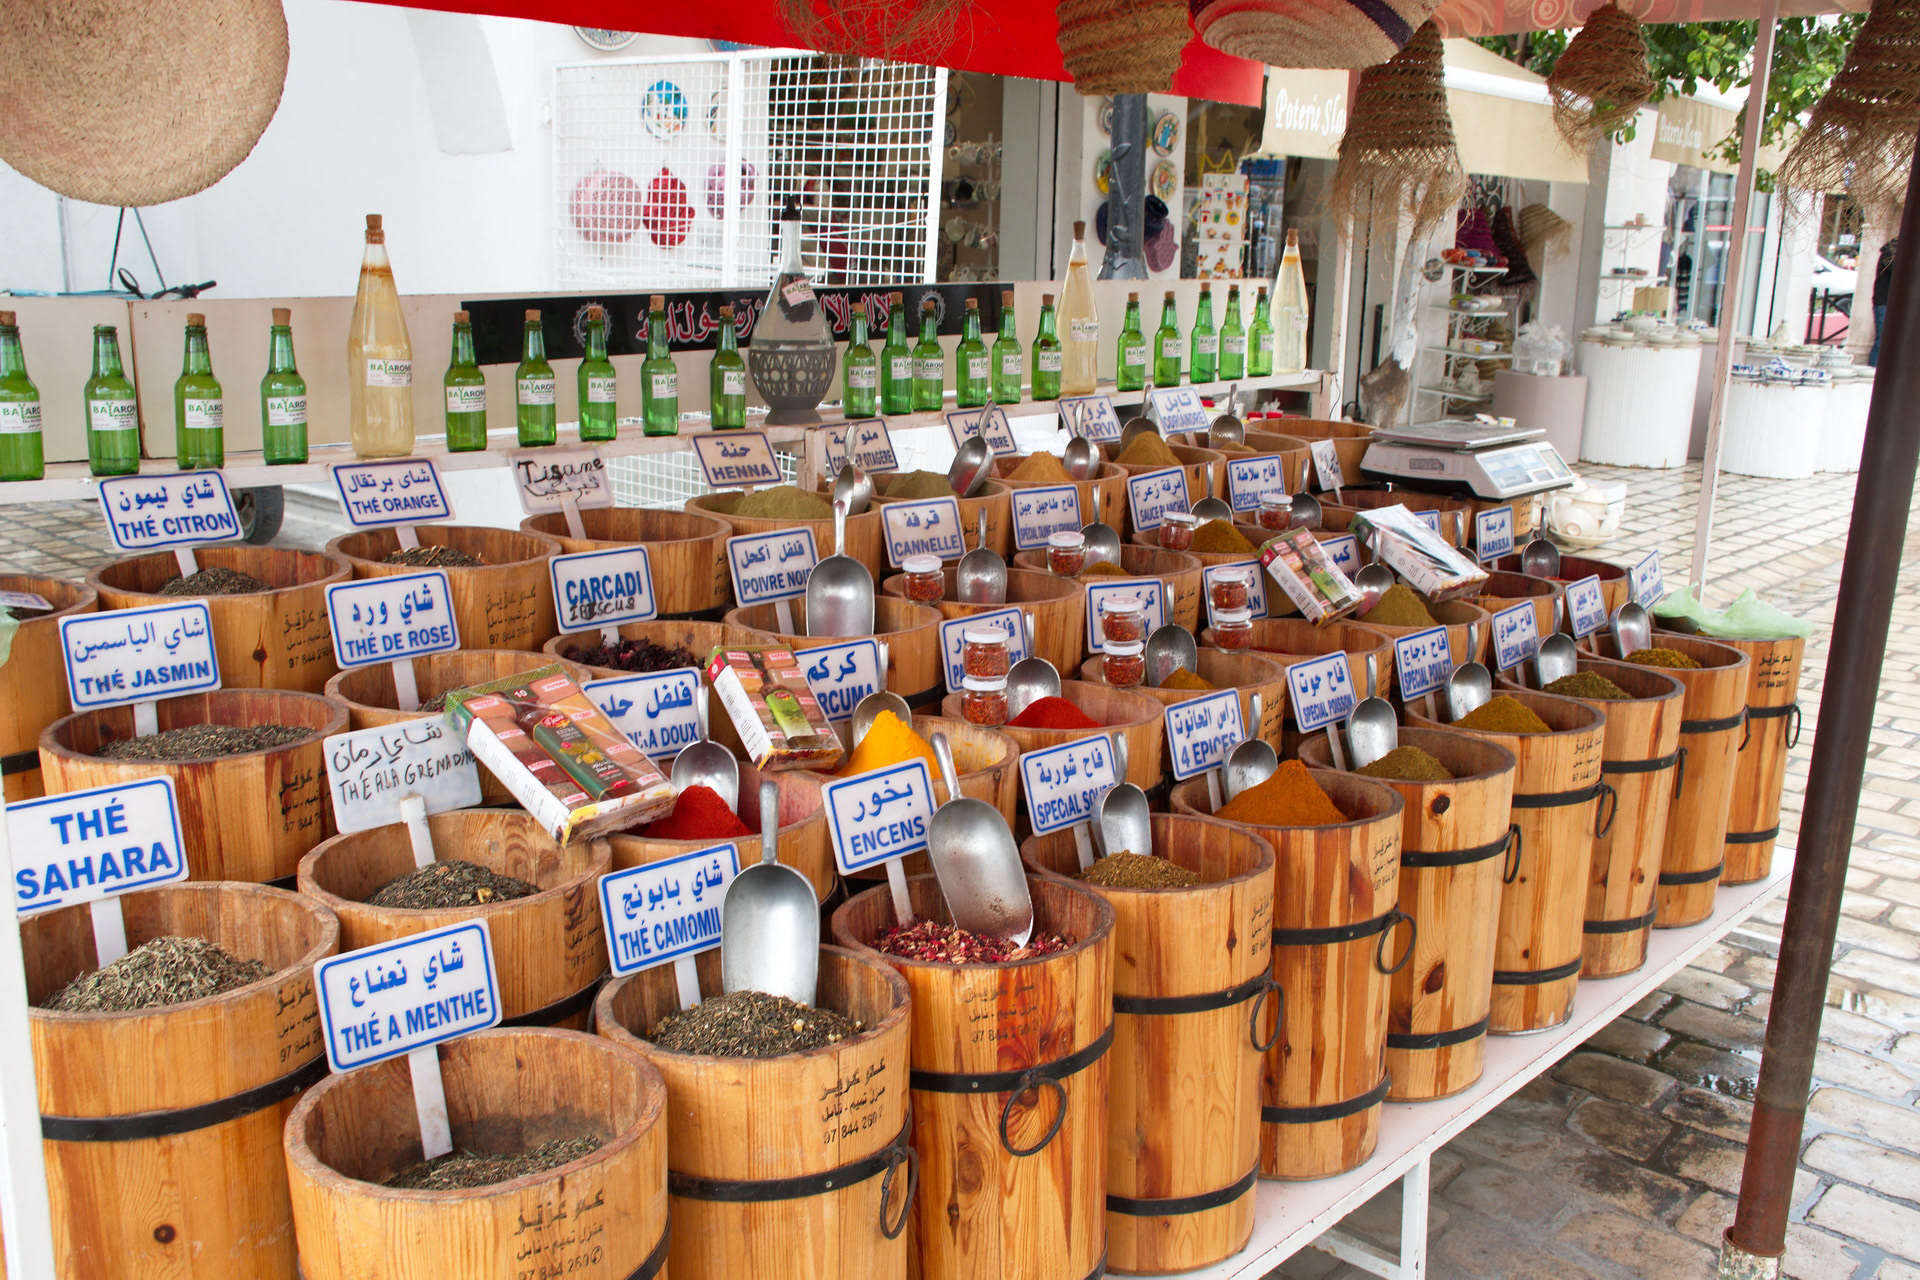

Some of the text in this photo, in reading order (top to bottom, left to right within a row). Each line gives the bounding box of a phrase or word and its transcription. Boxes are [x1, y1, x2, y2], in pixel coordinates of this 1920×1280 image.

[1275, 88, 1347, 136] Poterie Sla
[1165, 392, 1192, 413] تابل
[1084, 421, 1117, 437] ARVI
[1163, 411, 1205, 430] CORIANDRE
[715, 440, 751, 459] حنة
[711, 463, 772, 481] HENNA
[119, 478, 215, 512] شاي ليمون
[352, 494, 439, 515] THÉ ORANGE
[119, 512, 233, 541] THÉ CITRON
[1139, 505, 1160, 522] SAUCE
[741, 539, 805, 569] فلفل أكحل
[893, 534, 960, 557] CANNELLE
[1482, 536, 1511, 555] HARISSA
[565, 571, 643, 605] CARCADI
[743, 572, 784, 595] POIVRE
[352, 583, 435, 627] شاي ورد
[74, 616, 205, 663] شاي الياسمين
[345, 624, 451, 658] THÉ DE ROSE
[1402, 643, 1427, 666] دجاج
[80, 660, 211, 695] THÉ JASMIN
[1299, 672, 1322, 697] حوت
[646, 680, 693, 719] فلفل
[661, 722, 699, 747] DOUX
[1036, 753, 1077, 790] شوربة
[1181, 745, 1191, 769] 4
[852, 779, 914, 823] بخور
[50, 796, 129, 846] THÉ
[850, 815, 926, 856] ENCENS
[15, 841, 174, 901] SAHARA
[622, 859, 724, 920] شاي بابونج
[619, 920, 652, 961] THÉ
[349, 941, 465, 1008] شاي نعناع
[341, 988, 488, 1053] THÉ A MENTHE
[280, 1044, 292, 1063] 97
[841, 1119, 859, 1139] 844
